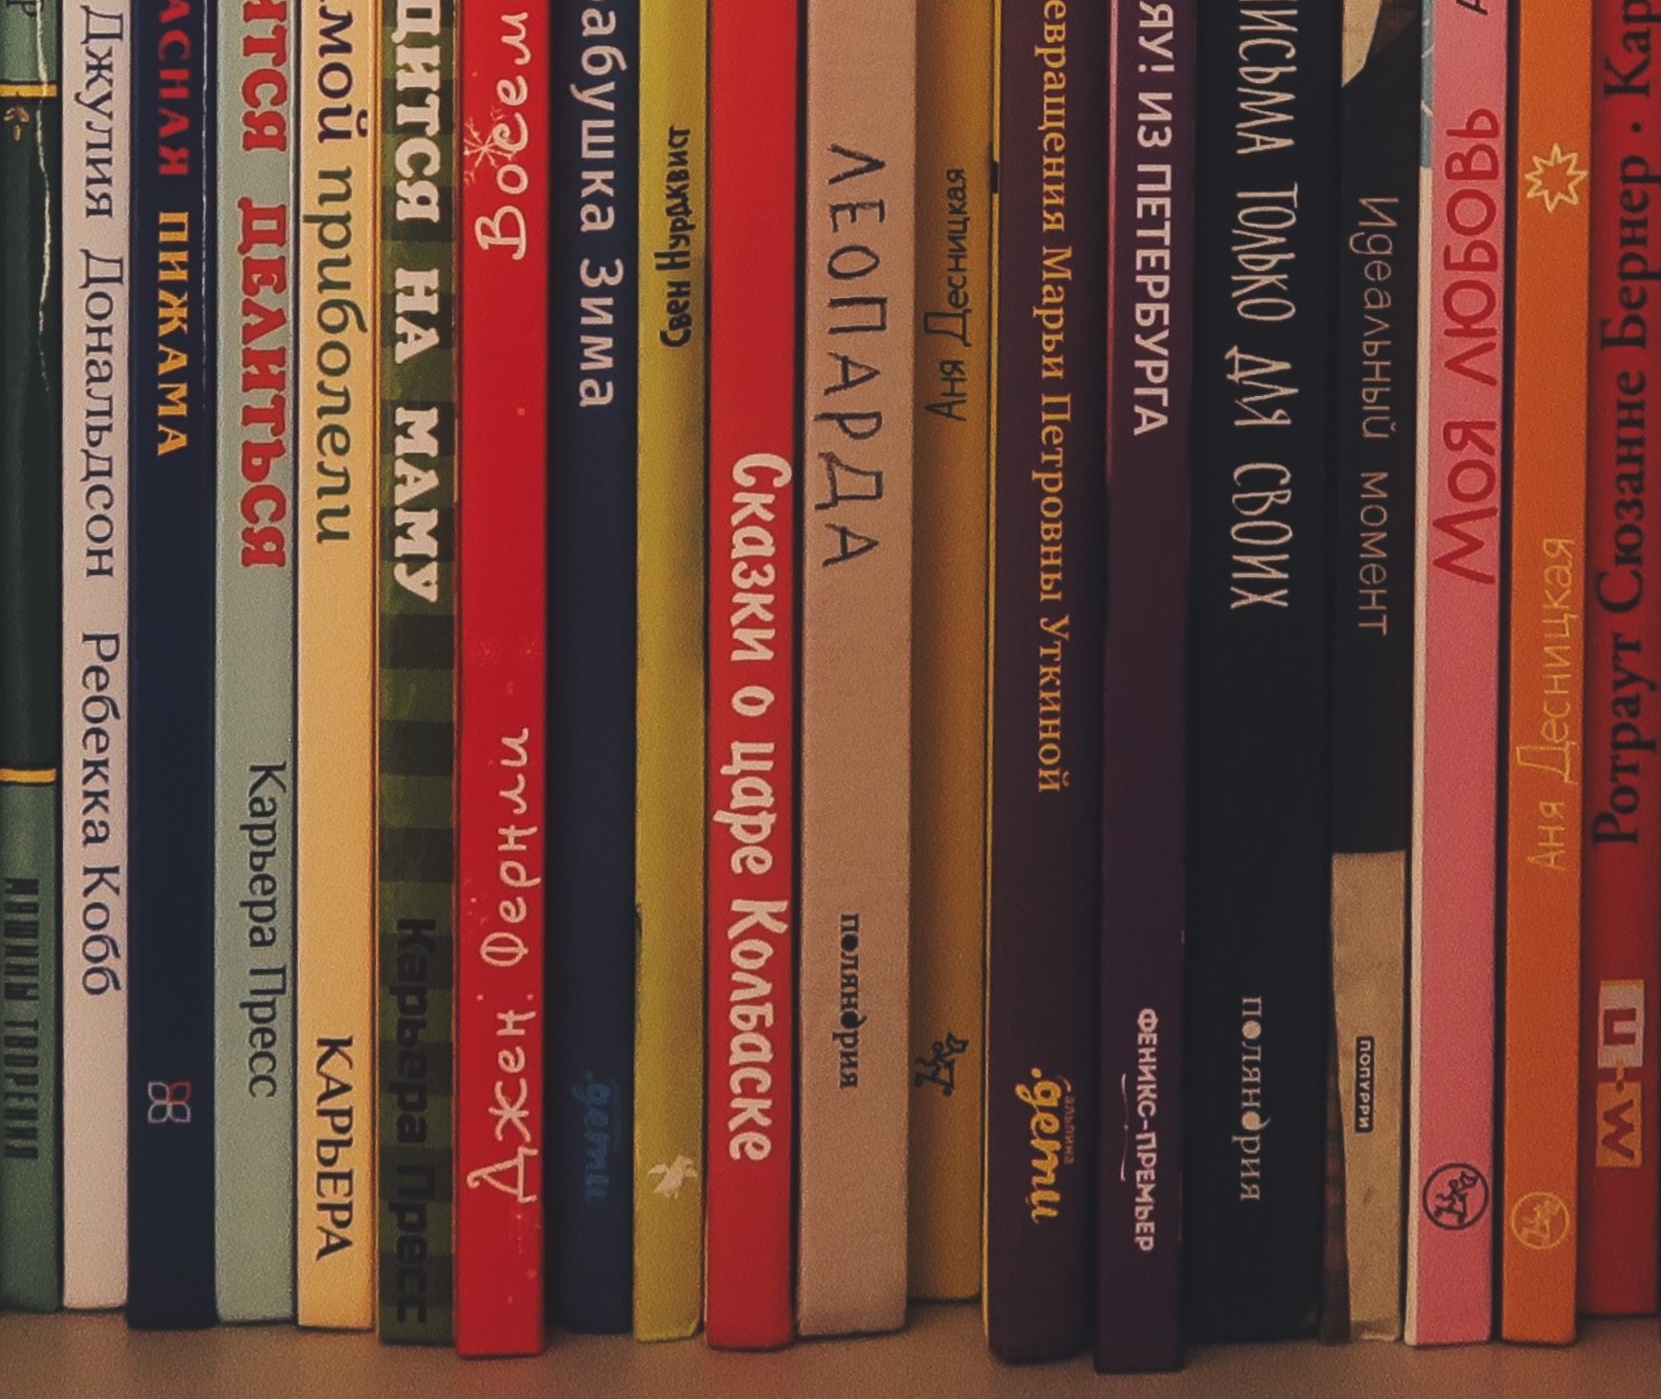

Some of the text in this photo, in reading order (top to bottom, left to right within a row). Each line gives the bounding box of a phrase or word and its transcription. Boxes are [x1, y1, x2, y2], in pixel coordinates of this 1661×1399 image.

[1137, 92, 1172, 148] ИЗ
[74, 5, 124, 577] Джулия Дональдсон
[158, 212, 188, 455] ПИЖАМА
[303, 167, 367, 543] приболели
[396, 268, 438, 363] НА
[579, 259, 624, 407] Зима
[814, 144, 888, 567] ЛЕОПАРДА
[1033, 246, 1072, 378] Марьи
[1134, 164, 1172, 435] ПЕТЕРБУРГА
[1231, 183, 1298, 321] ТОЛЬКО
[1433, 110, 1499, 584] МОЯ ЛЮБОВЬ
[1599, 156, 1659, 349] Бернер
[238, 198, 286, 566] ДЕЛИТЬСЯ
[1225, 345, 1299, 426] ДЛЯ
[1351, 197, 1399, 636] Идеальный момент
[394, 408, 438, 601] МАМУ
[1032, 394, 1071, 601] Петровны
[1230, 462, 1293, 609] СВОИХ
[1592, 372, 1645, 613] Сюзанне
[714, 454, 792, 1160] Сказки о царе Колбаске
[1038, 615, 1069, 791] Уткиной
[1588, 634, 1659, 847] Ротраут
[82, 634, 121, 995] Ребекка Кобб
[4, 879, 38, 1158] МАШИНЫ ТВОРЕНИЯ
[240, 762, 286, 1096] Карьера Пресс
[832, 914, 867, 1088] поляндрия
[317, 1037, 353, 1260] КАРЬЕРА
[1135, 1008, 1158, 1251] ФЕНИКС-ПРЕМЬЕР
[1232, 997, 1270, 1200] поляндрия
[1357, 1040, 1374, 1131] ПОПУРРИ
